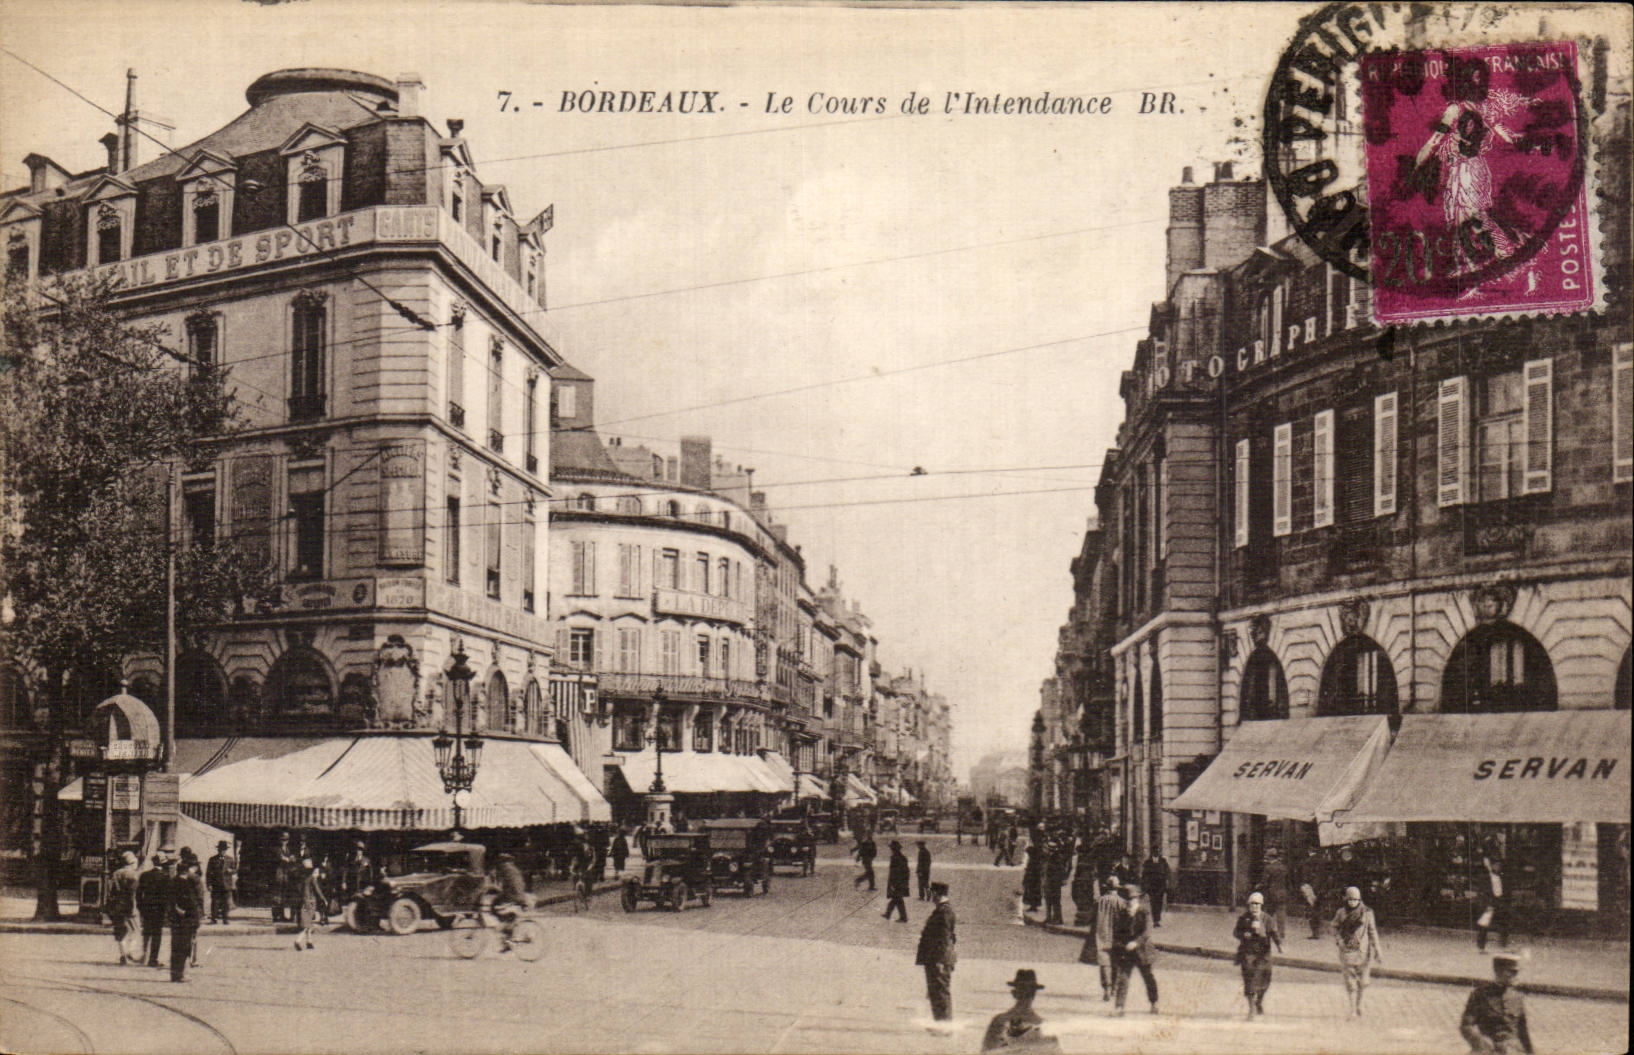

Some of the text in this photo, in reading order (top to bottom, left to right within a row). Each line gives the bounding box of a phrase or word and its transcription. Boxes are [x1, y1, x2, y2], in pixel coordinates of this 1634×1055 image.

[379, 210, 433, 237] GANTS
[164, 250, 199, 281] ET
[207, 239, 244, 273] DE
[254, 215, 355, 263] SPORT
[675, 594, 696, 612] LA
[1232, 760, 1314, 779] SERVAN
[1472, 756, 1619, 780] SERVAN
